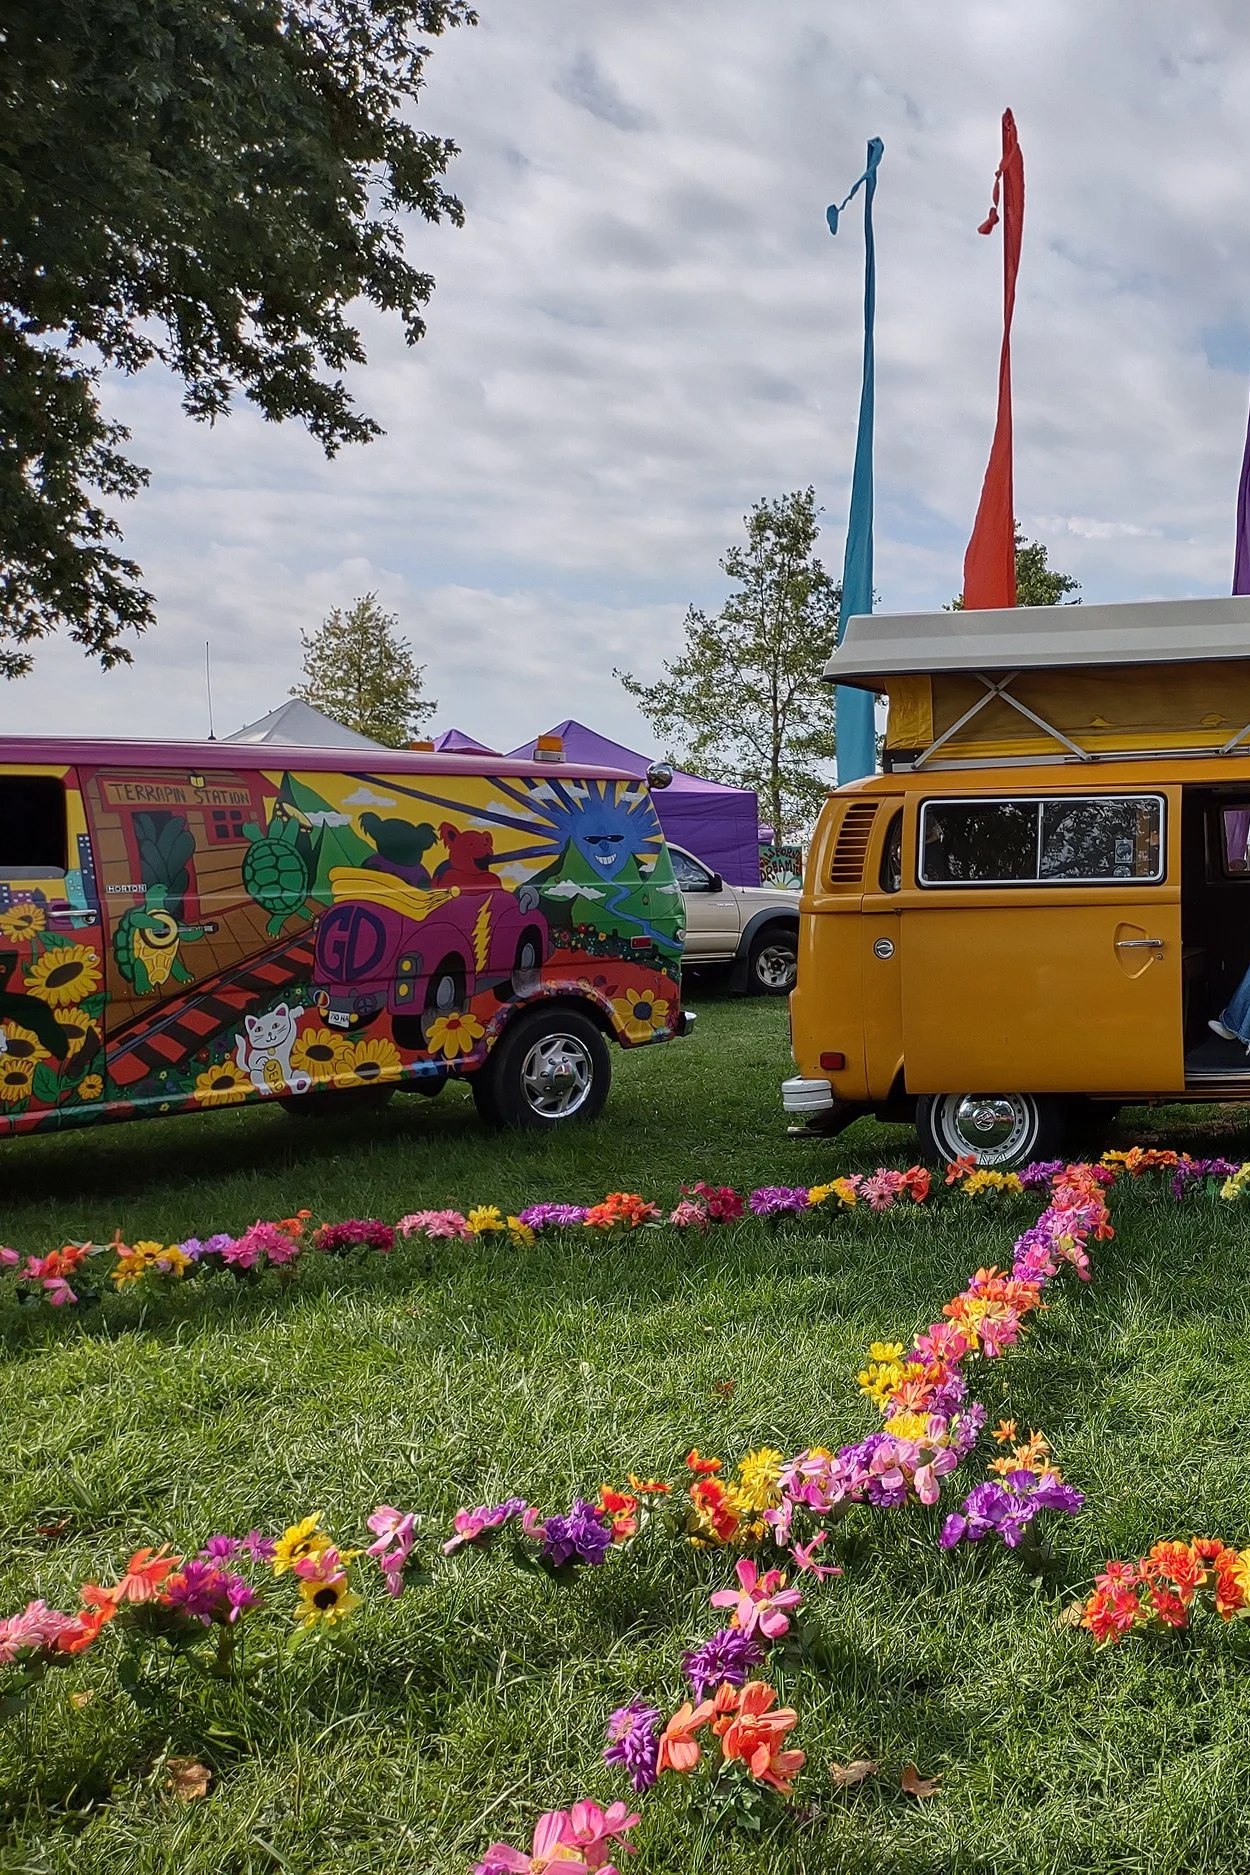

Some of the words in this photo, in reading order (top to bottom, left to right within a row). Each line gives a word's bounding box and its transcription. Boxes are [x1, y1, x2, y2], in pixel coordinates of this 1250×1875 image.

[108, 783, 186, 803] TERRAPIN
[193, 789, 250, 805] STATION
[107, 884, 147, 893] HORTON
[317, 905, 387, 981] GD
[266, 1062, 284, 1091] DEAD
